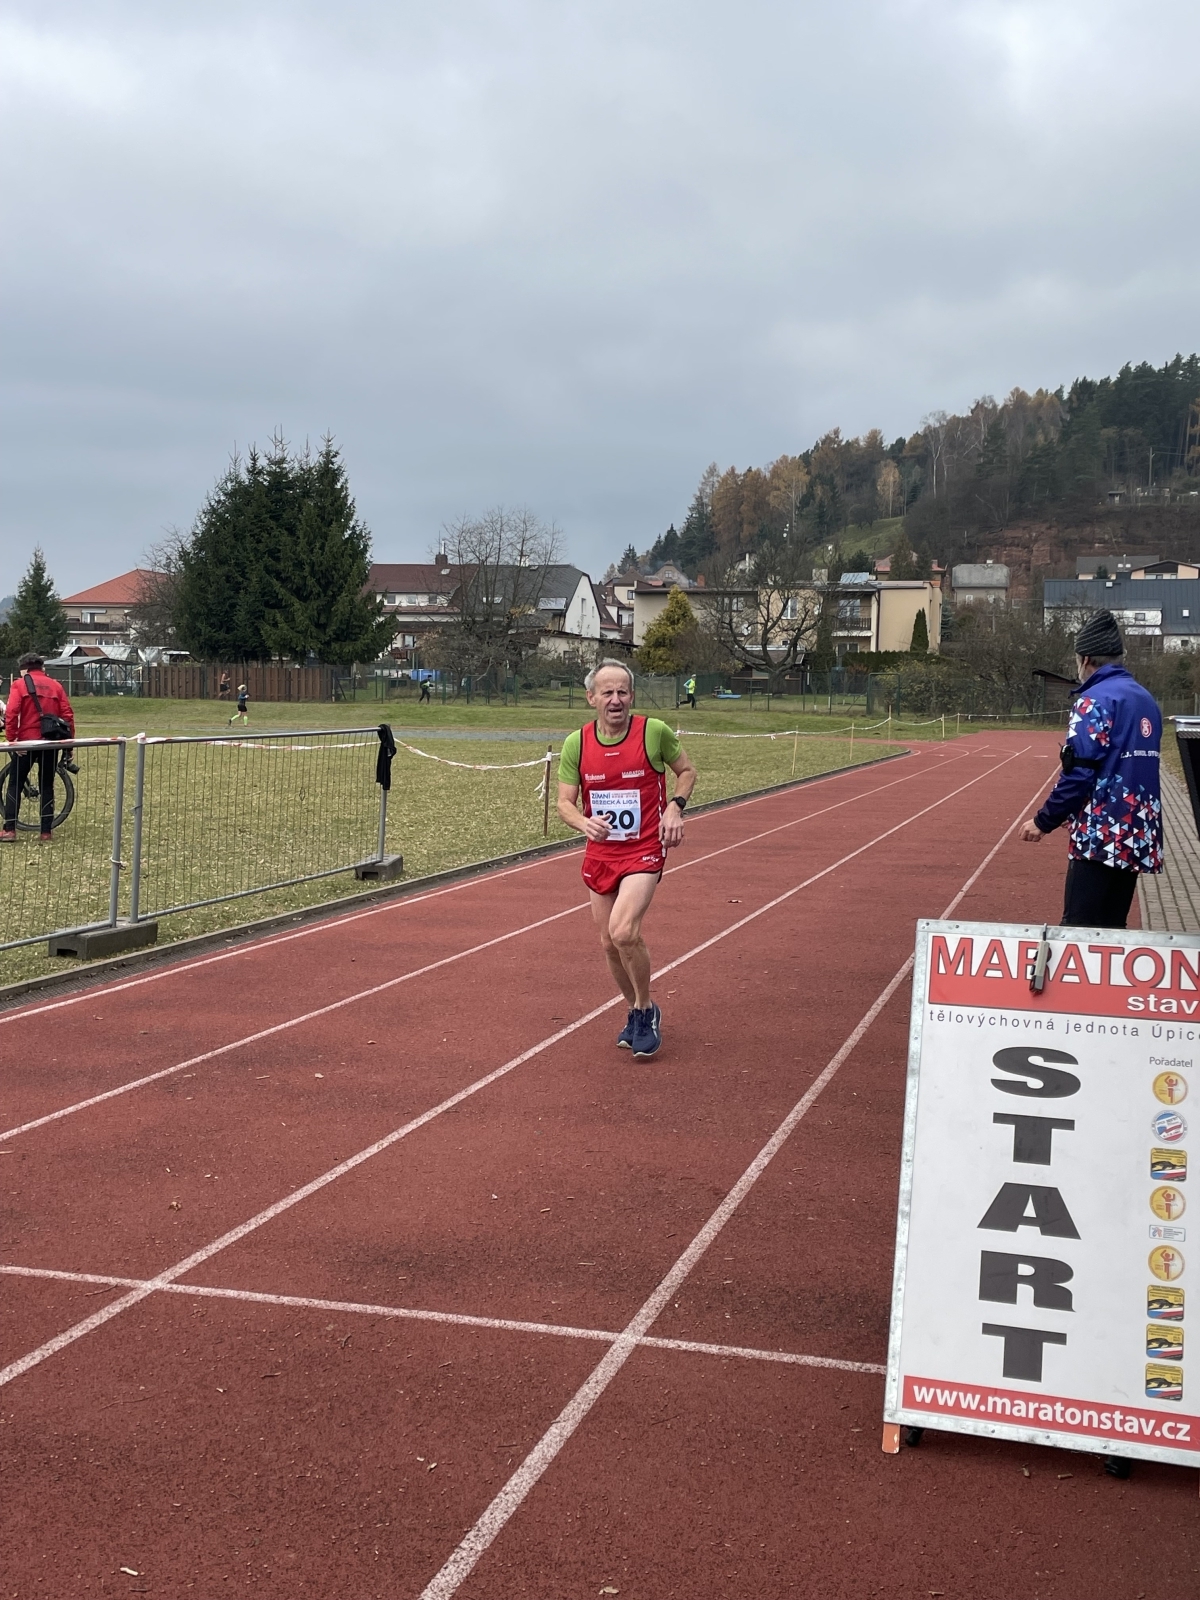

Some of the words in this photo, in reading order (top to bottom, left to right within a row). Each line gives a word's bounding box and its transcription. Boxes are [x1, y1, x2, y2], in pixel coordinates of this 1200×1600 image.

[597, 810, 635, 830] 20
[1127, 994, 1200, 1014] stav
[929, 1009, 1056, 1030] tělovýchovná
[1064, 1019, 1140, 1037] jednota
[1151, 1023, 1200, 1042] Úpic
[1149, 1056, 1193, 1068] Pořadatel
[977, 1046, 1081, 1383] START
[912, 1384, 1192, 1442] www.maratonstav.cz
